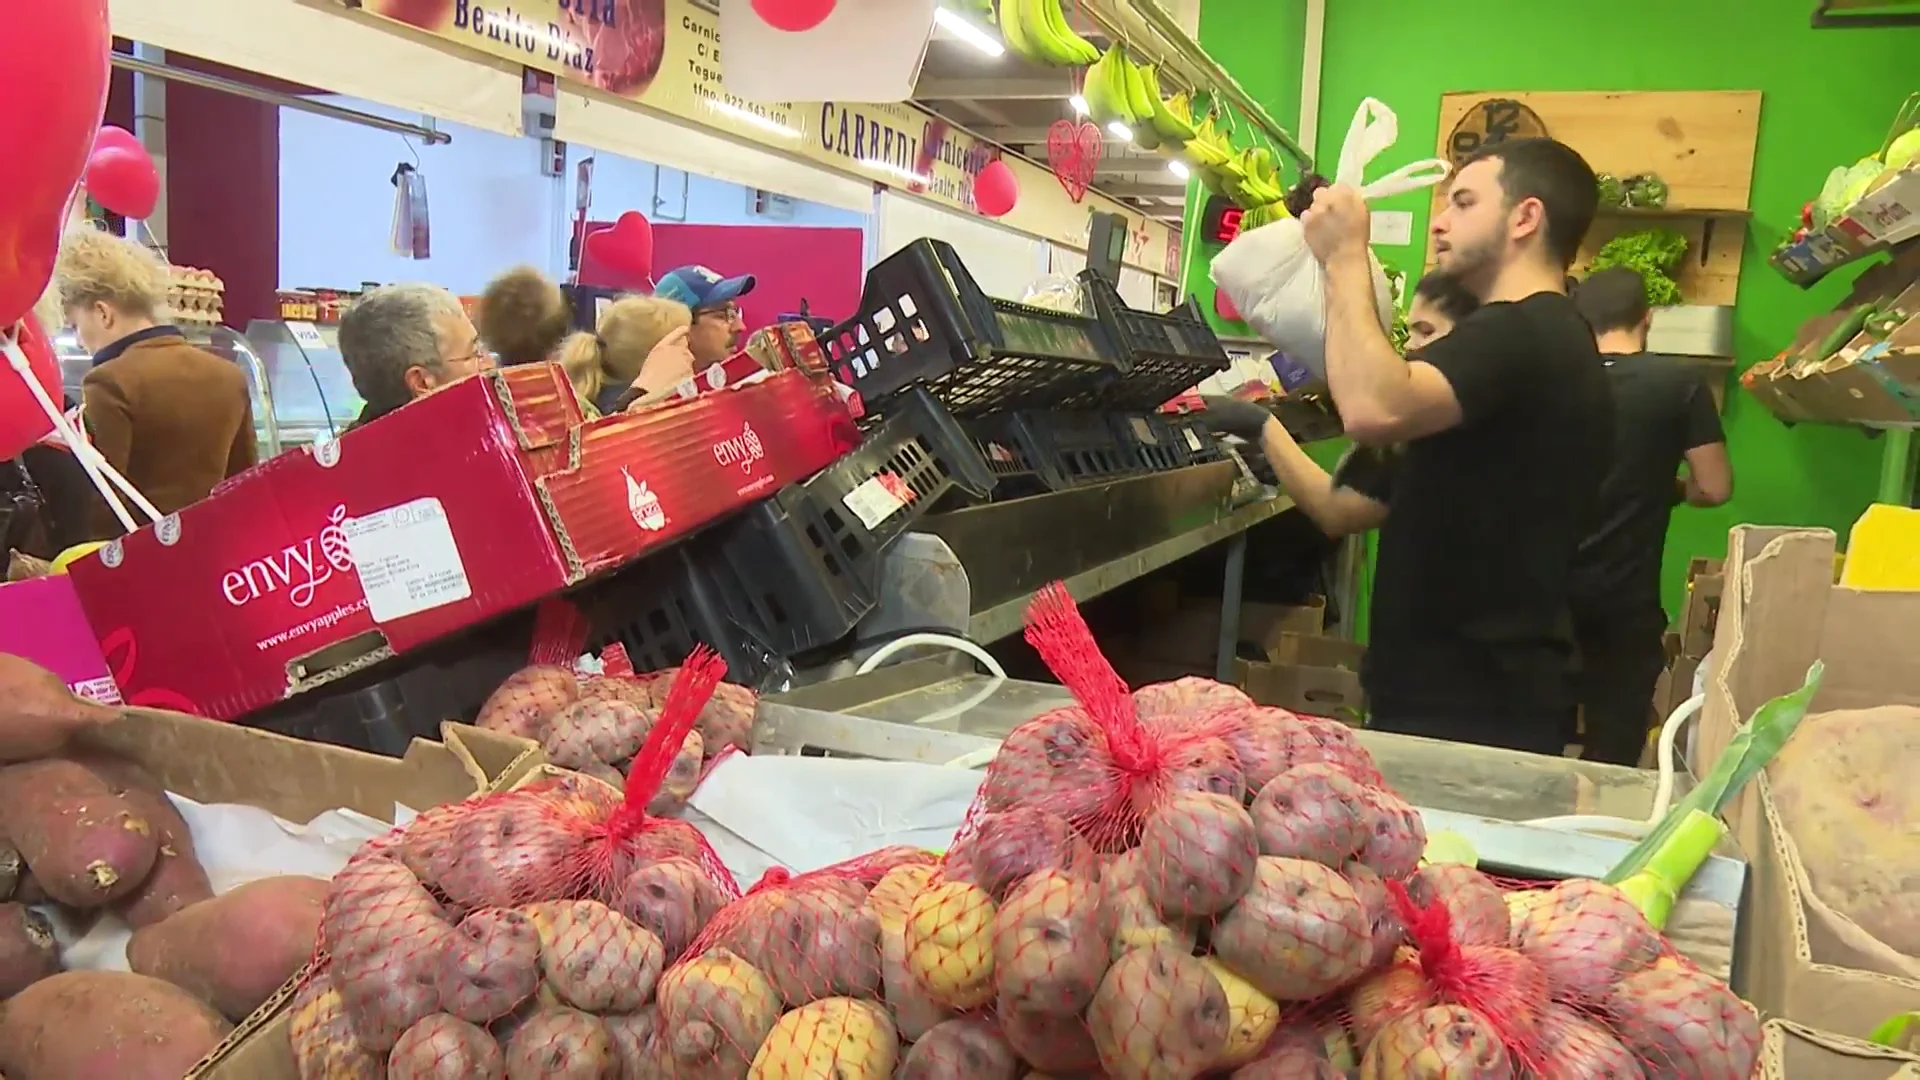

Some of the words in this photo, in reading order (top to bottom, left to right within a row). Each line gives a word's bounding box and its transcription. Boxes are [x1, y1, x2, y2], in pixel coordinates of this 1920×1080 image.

[454, 0, 536, 53] Benito
[724, 92, 745, 111] 922
[770, 110, 787, 126] 100
[1483, 104, 1520, 134] 12
[713, 435, 754, 475] envy
[222, 537, 332, 608] envy
